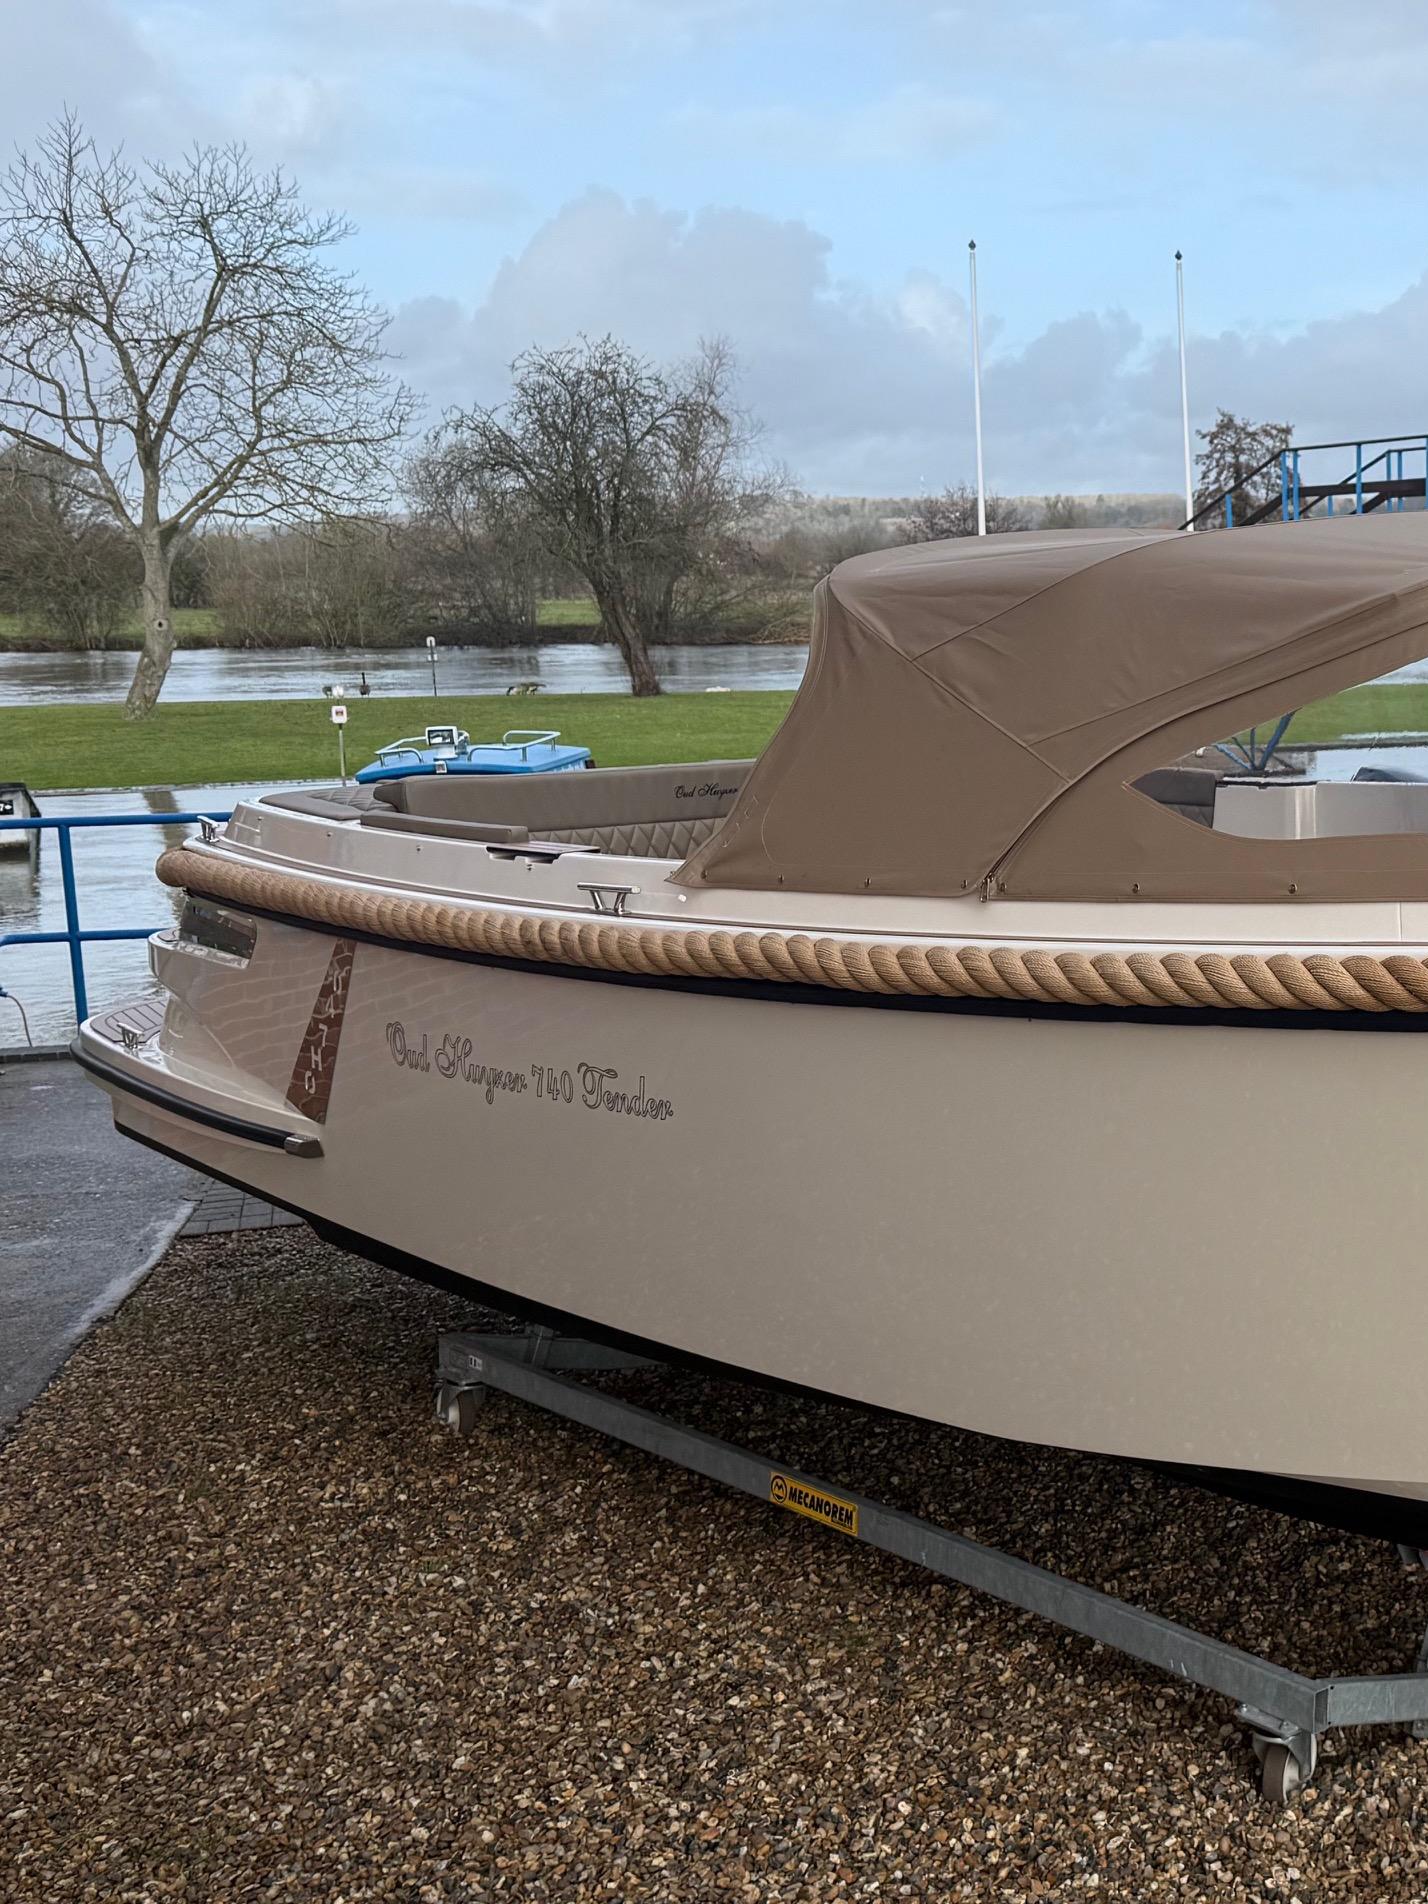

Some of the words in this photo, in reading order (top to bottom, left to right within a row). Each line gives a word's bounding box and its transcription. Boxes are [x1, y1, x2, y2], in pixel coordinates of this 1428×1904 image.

[674, 785, 697, 799] Oud
[386, 1021, 430, 1073] Oud
[435, 1033, 527, 1104] Huyzer
[531, 1064, 573, 1103] 740
[577, 1062, 674, 1120] Tender
[788, 1486, 853, 1527] MECANOREM
